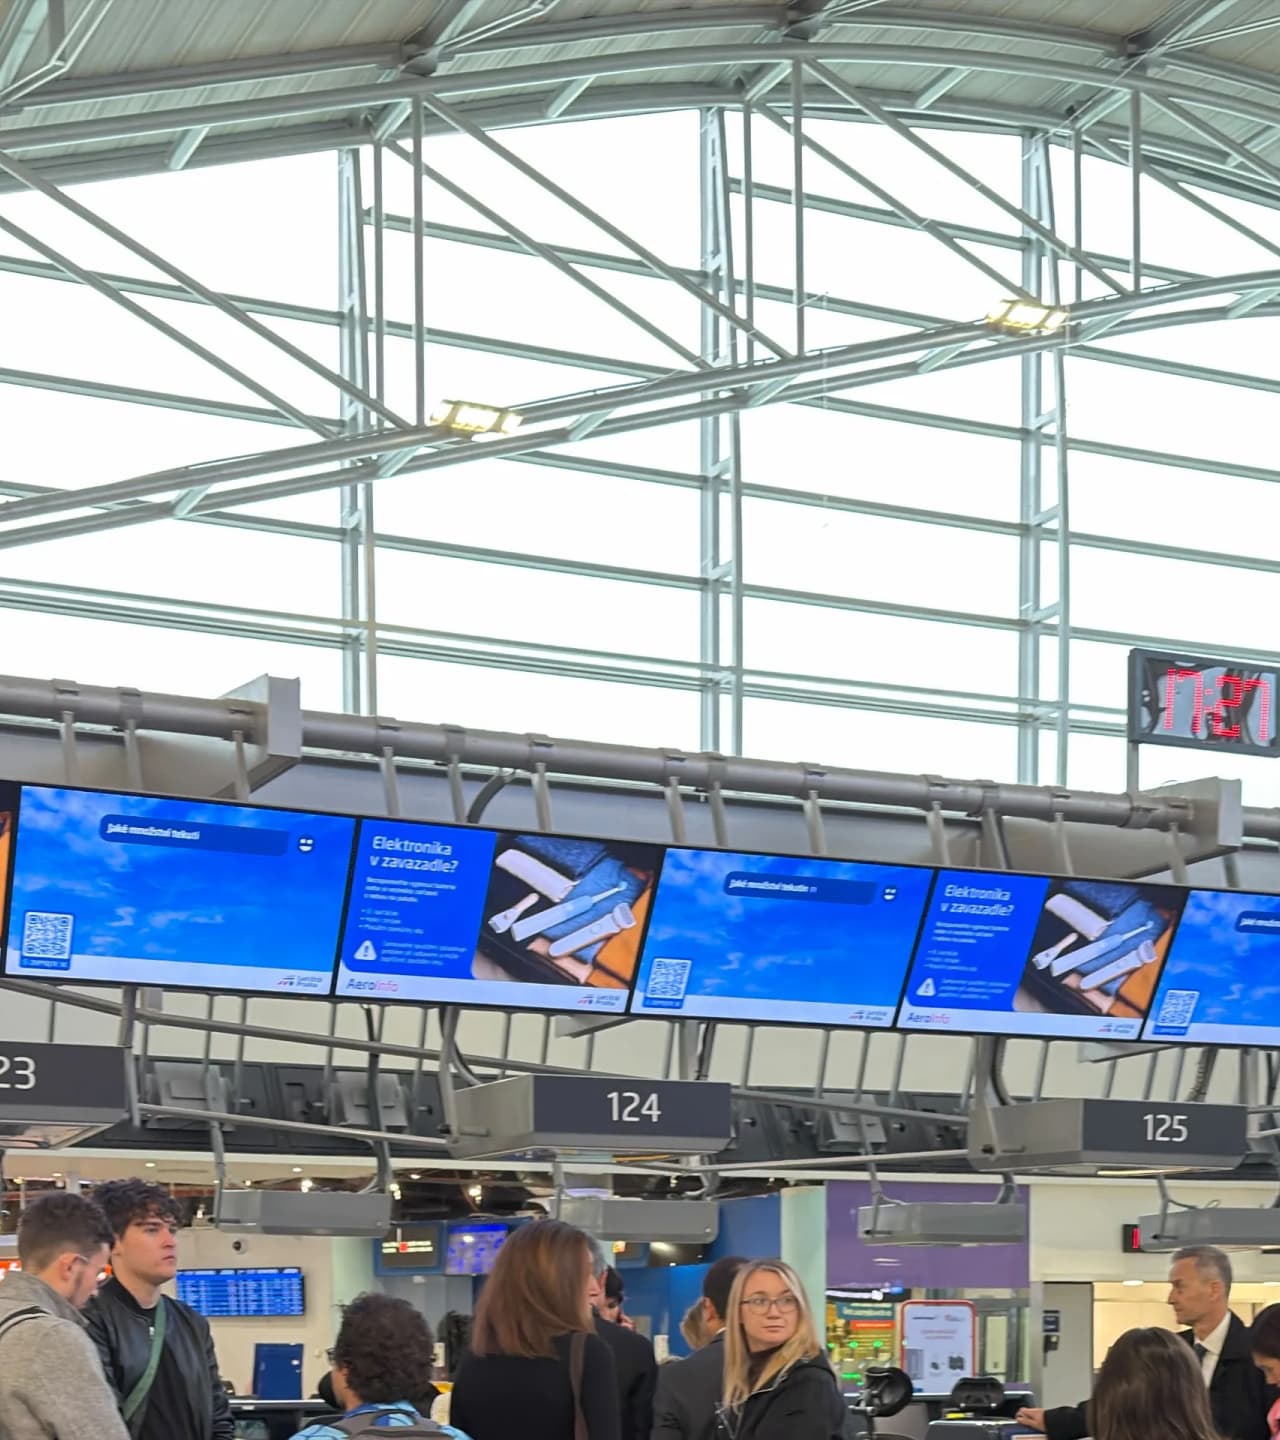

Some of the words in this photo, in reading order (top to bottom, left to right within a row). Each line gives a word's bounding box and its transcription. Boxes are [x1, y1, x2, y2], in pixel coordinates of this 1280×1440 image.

[1163, 667, 1270, 741] 17:27
[373, 836, 452, 855] Elektronika
[370, 857, 377, 867] v
[381, 856, 459, 872] zavazadle?
[945, 884, 1010, 901] Elektronika
[606, 1091, 662, 1123] 124
[1143, 1113, 1188, 1143] 125
